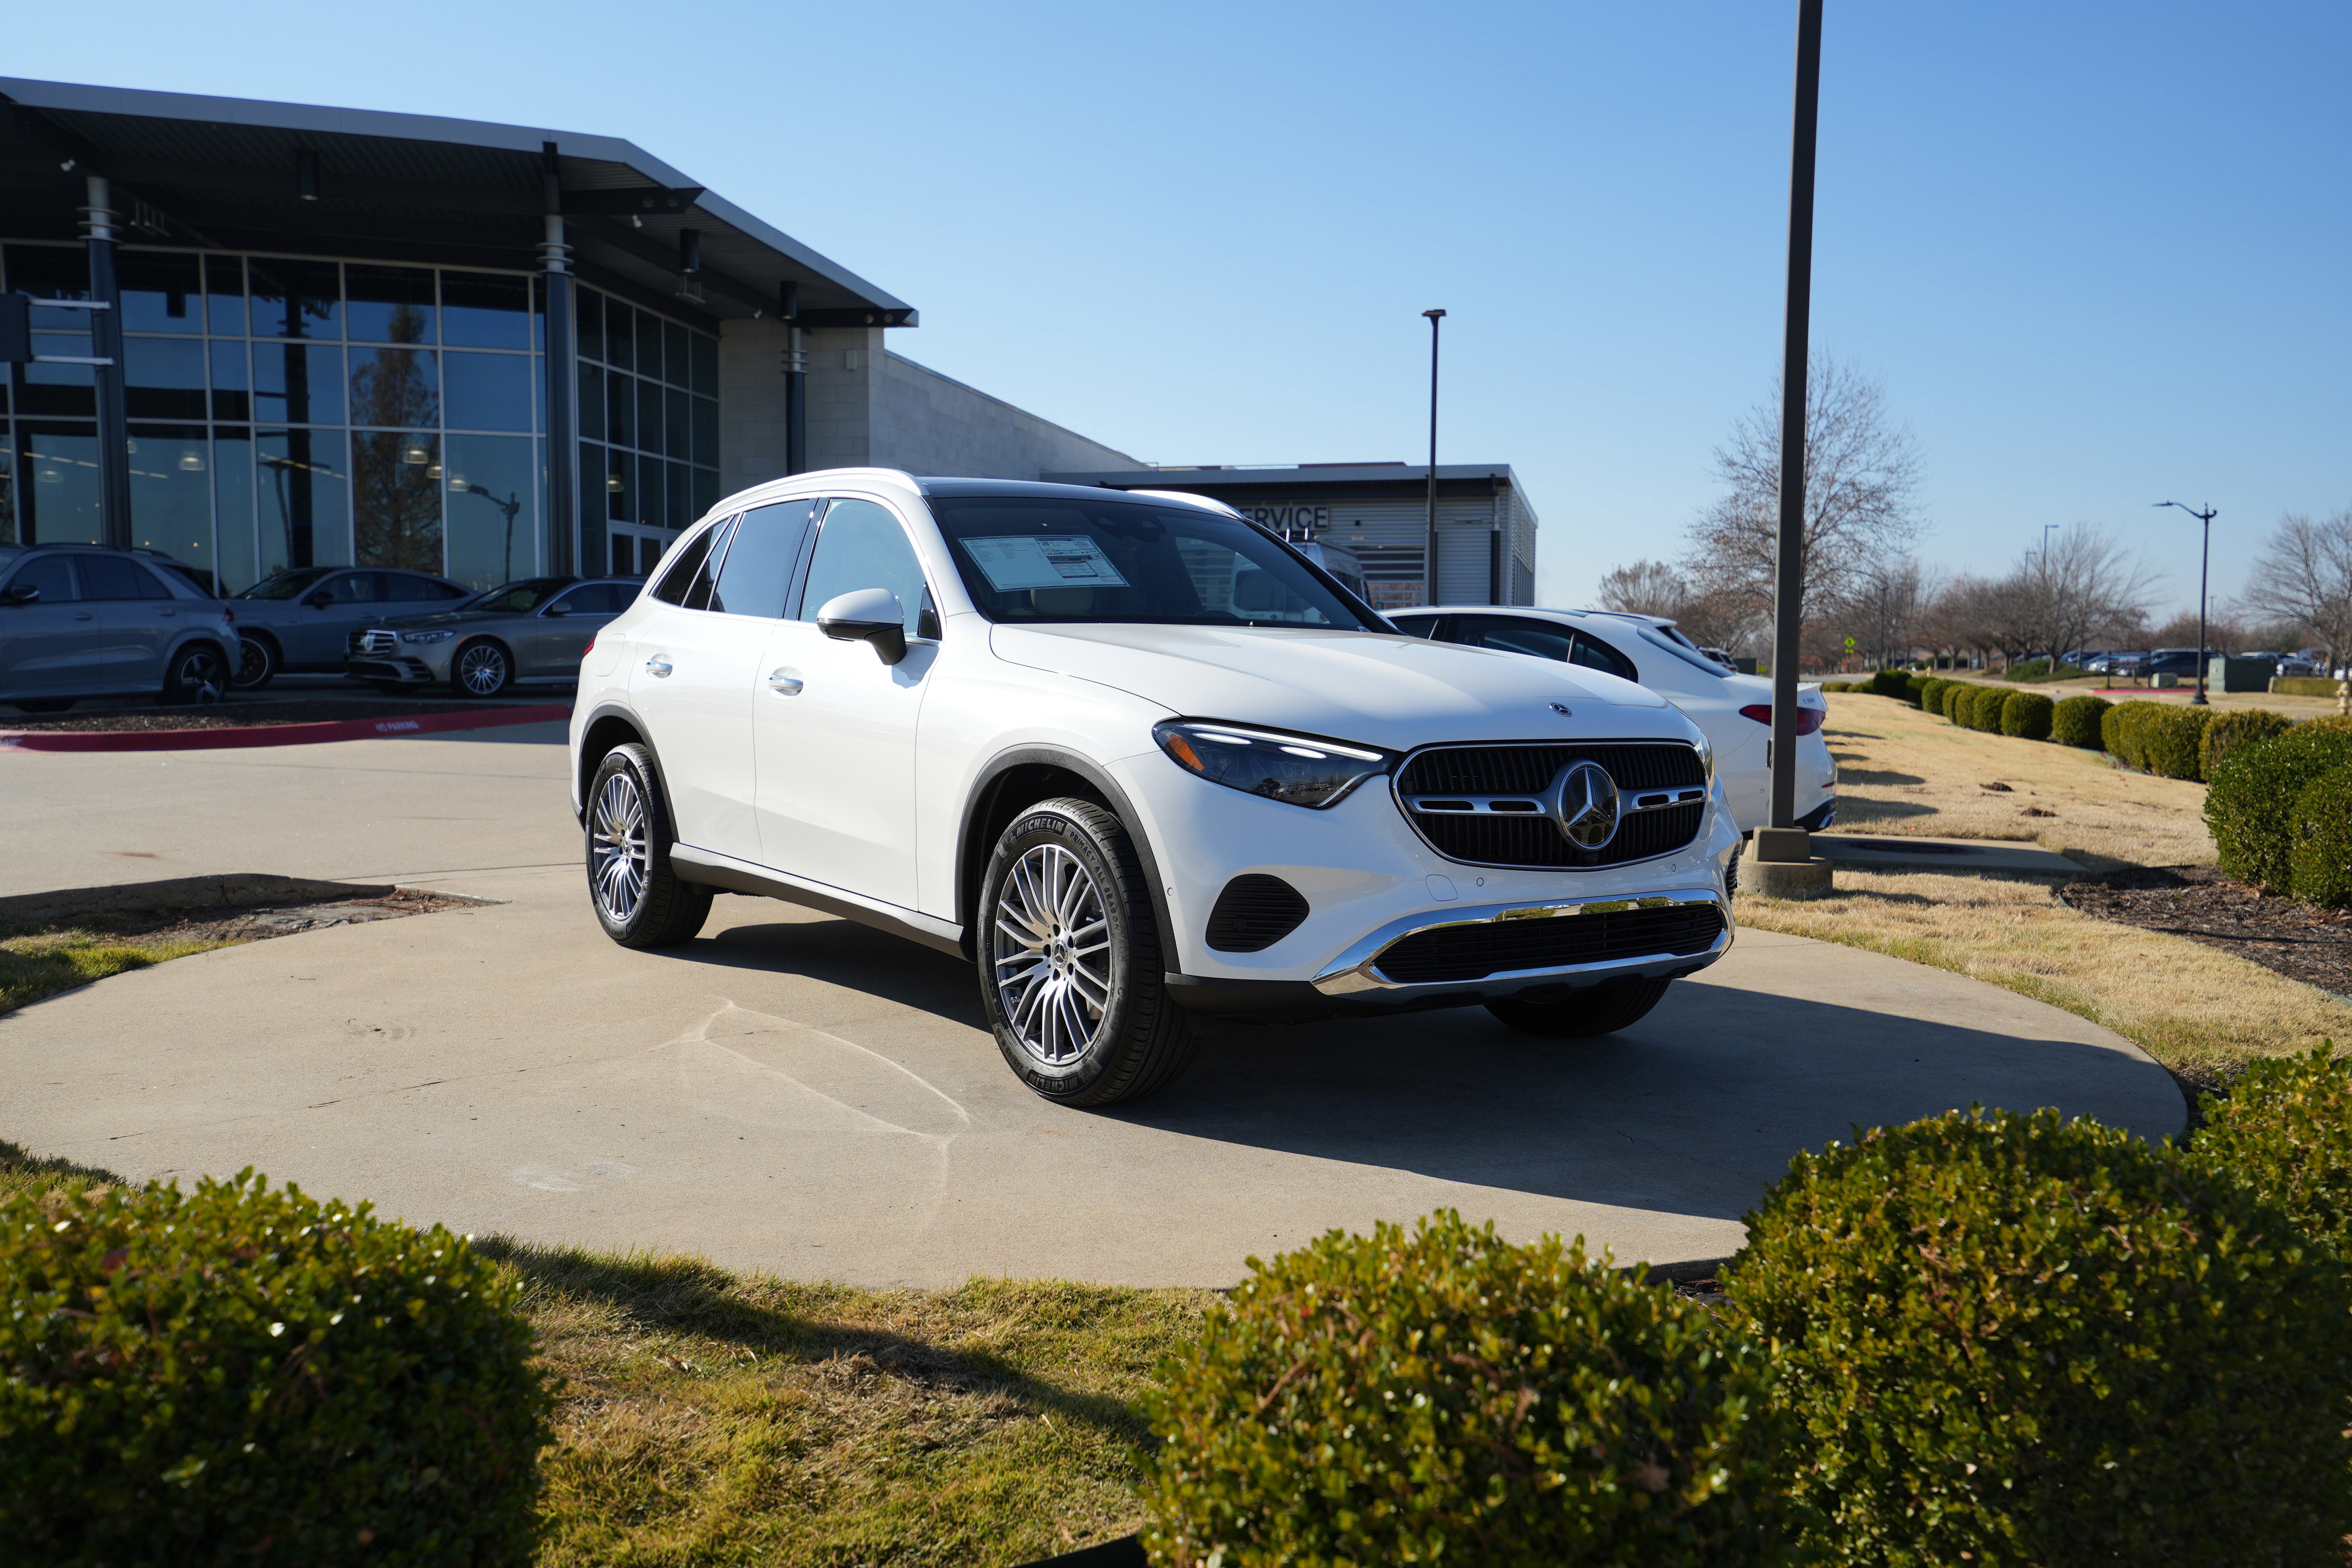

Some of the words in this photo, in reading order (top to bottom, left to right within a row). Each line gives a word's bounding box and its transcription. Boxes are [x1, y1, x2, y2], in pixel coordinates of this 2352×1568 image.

[1240, 507, 1327, 529] ERVICE
[1016, 818, 1065, 838] MICHELIN
[1069, 831, 1096, 862] PRIMACY
[1094, 866, 1105, 884] ALL
[1105, 887, 1120, 931] SEASON
[996, 1030, 1002, 1038] 19
[1005, 1048, 1023, 1072] 235/55
[1029, 1073, 1078, 1091] MICHELIN
